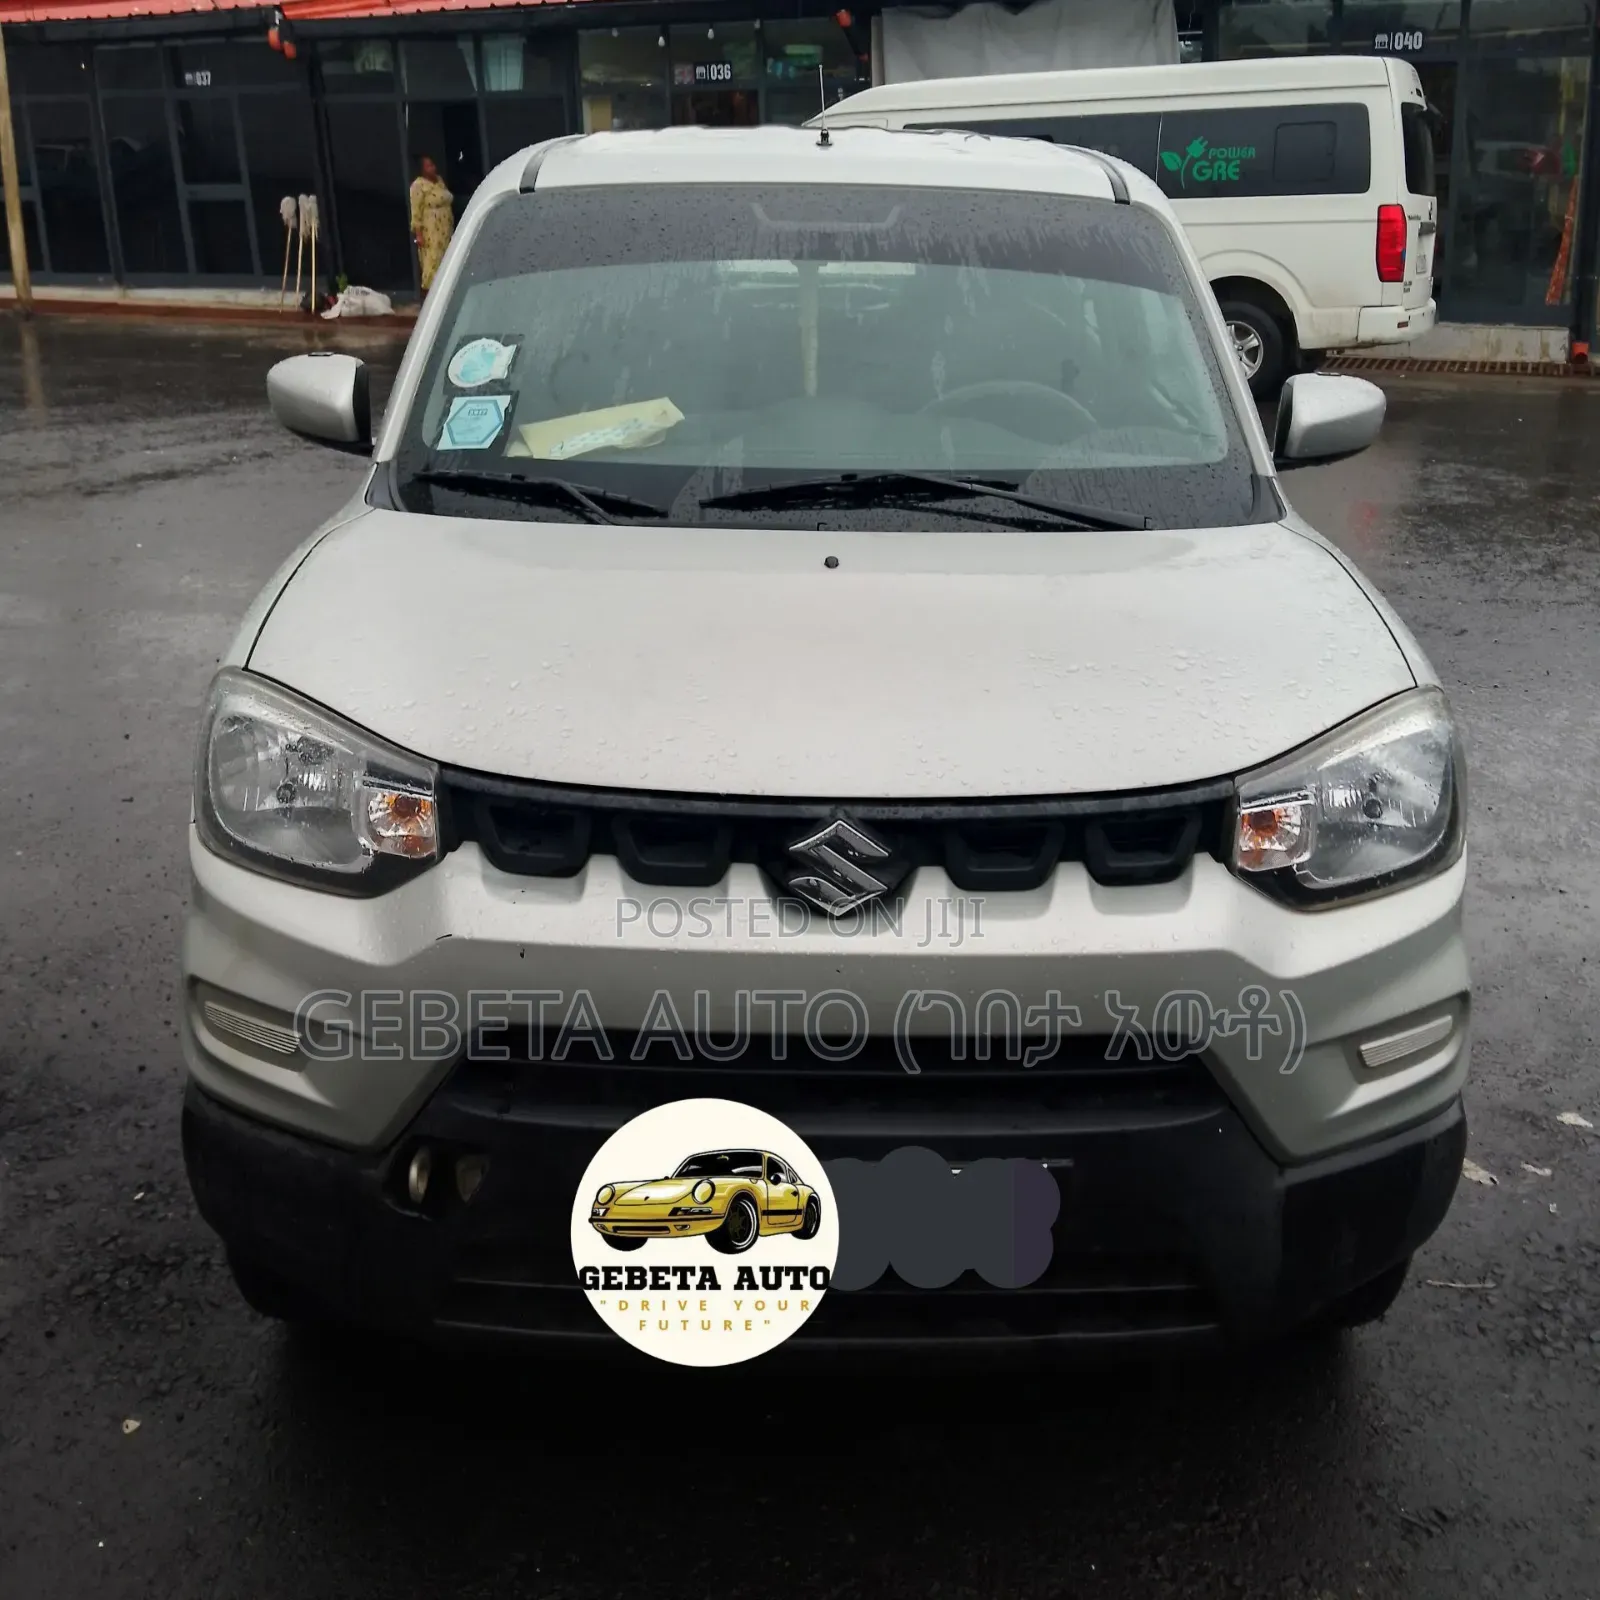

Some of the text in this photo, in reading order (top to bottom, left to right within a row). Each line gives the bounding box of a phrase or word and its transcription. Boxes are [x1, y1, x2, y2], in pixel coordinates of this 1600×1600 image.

[1394, 31, 1423, 50] 040
[710, 64, 731, 81] 036
[1208, 146, 1256, 159] POWER
